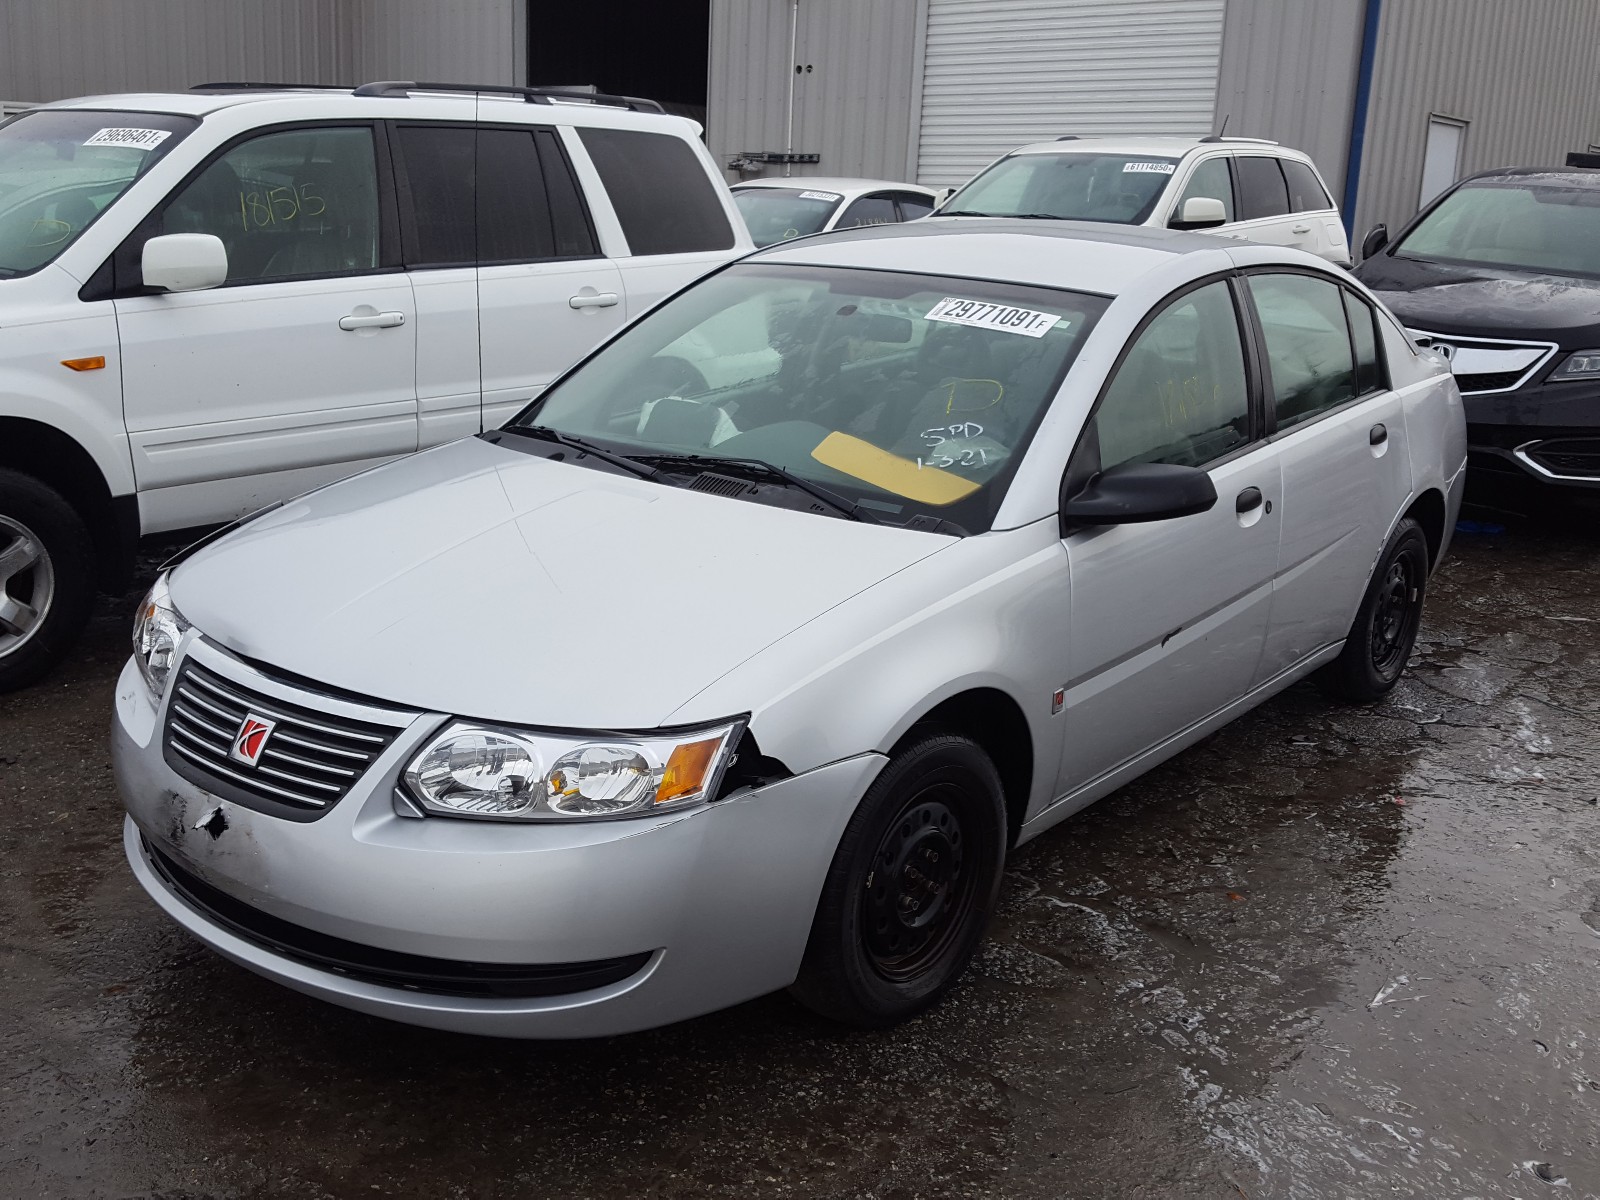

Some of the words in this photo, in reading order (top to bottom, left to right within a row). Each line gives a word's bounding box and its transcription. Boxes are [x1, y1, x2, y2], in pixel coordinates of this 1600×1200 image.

[95, 129, 160, 143] 29696461
[943, 300, 1043, 329] 29771091
[920, 422, 984, 447] SPD
